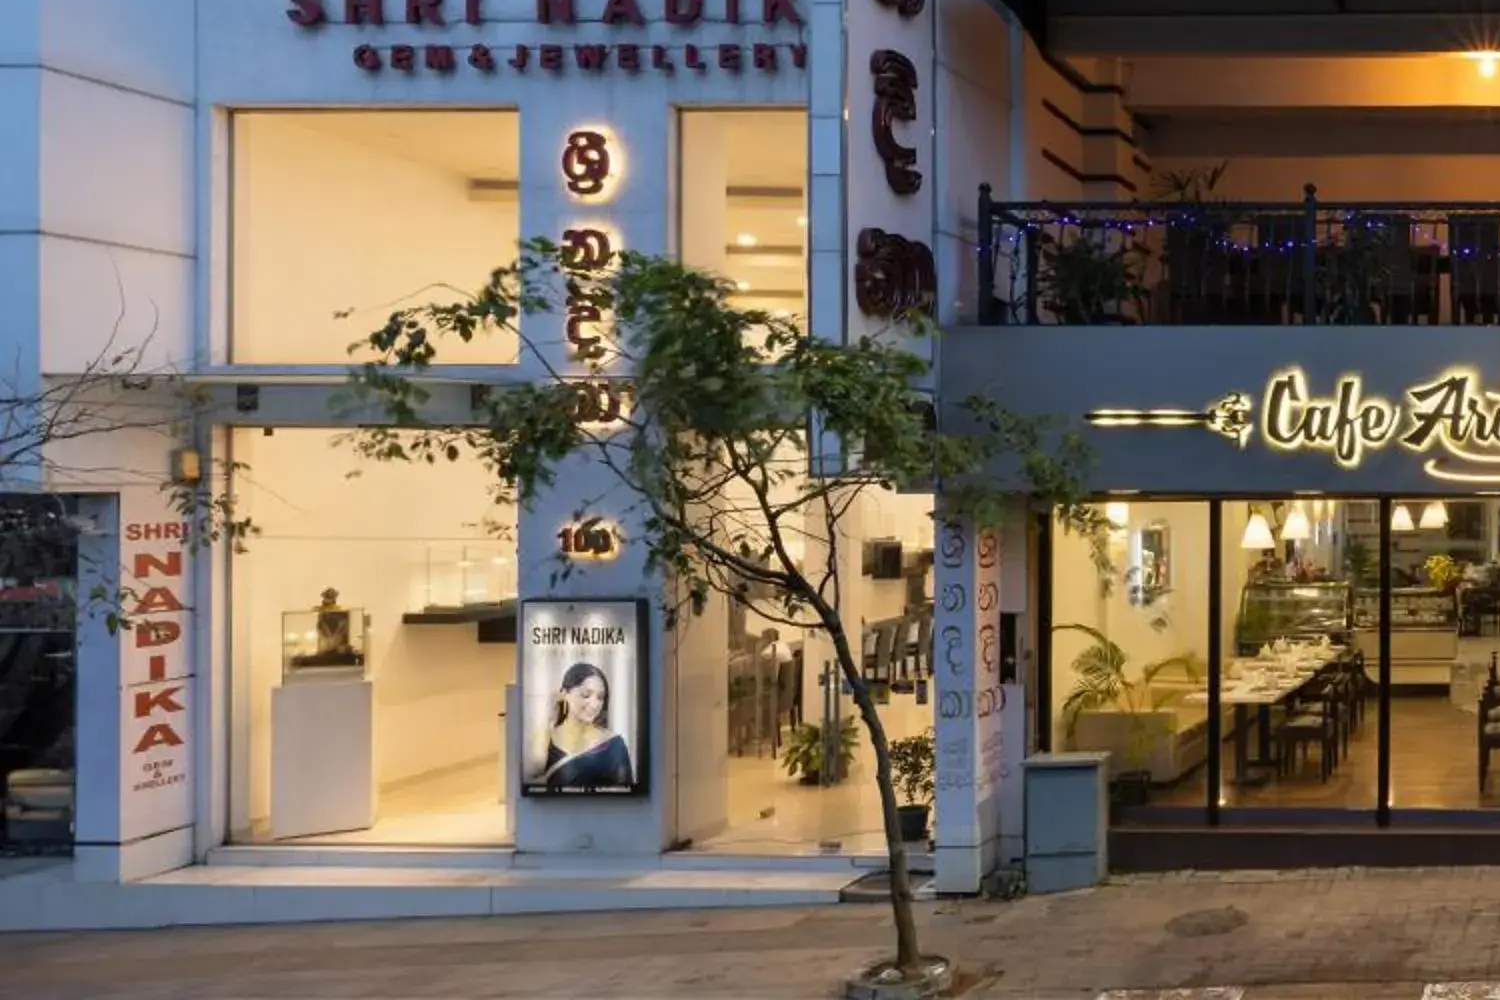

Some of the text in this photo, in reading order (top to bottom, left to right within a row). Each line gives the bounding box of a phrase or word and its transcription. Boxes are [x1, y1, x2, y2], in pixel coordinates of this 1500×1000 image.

[352, 42, 807, 75] GEM & JEWELLERY
[1266, 373, 1396, 463] Cafe
[125, 521, 190, 542] SHRI
[532, 626, 625, 645] SHRI NADIKA
[132, 551, 186, 754] NADIKA
